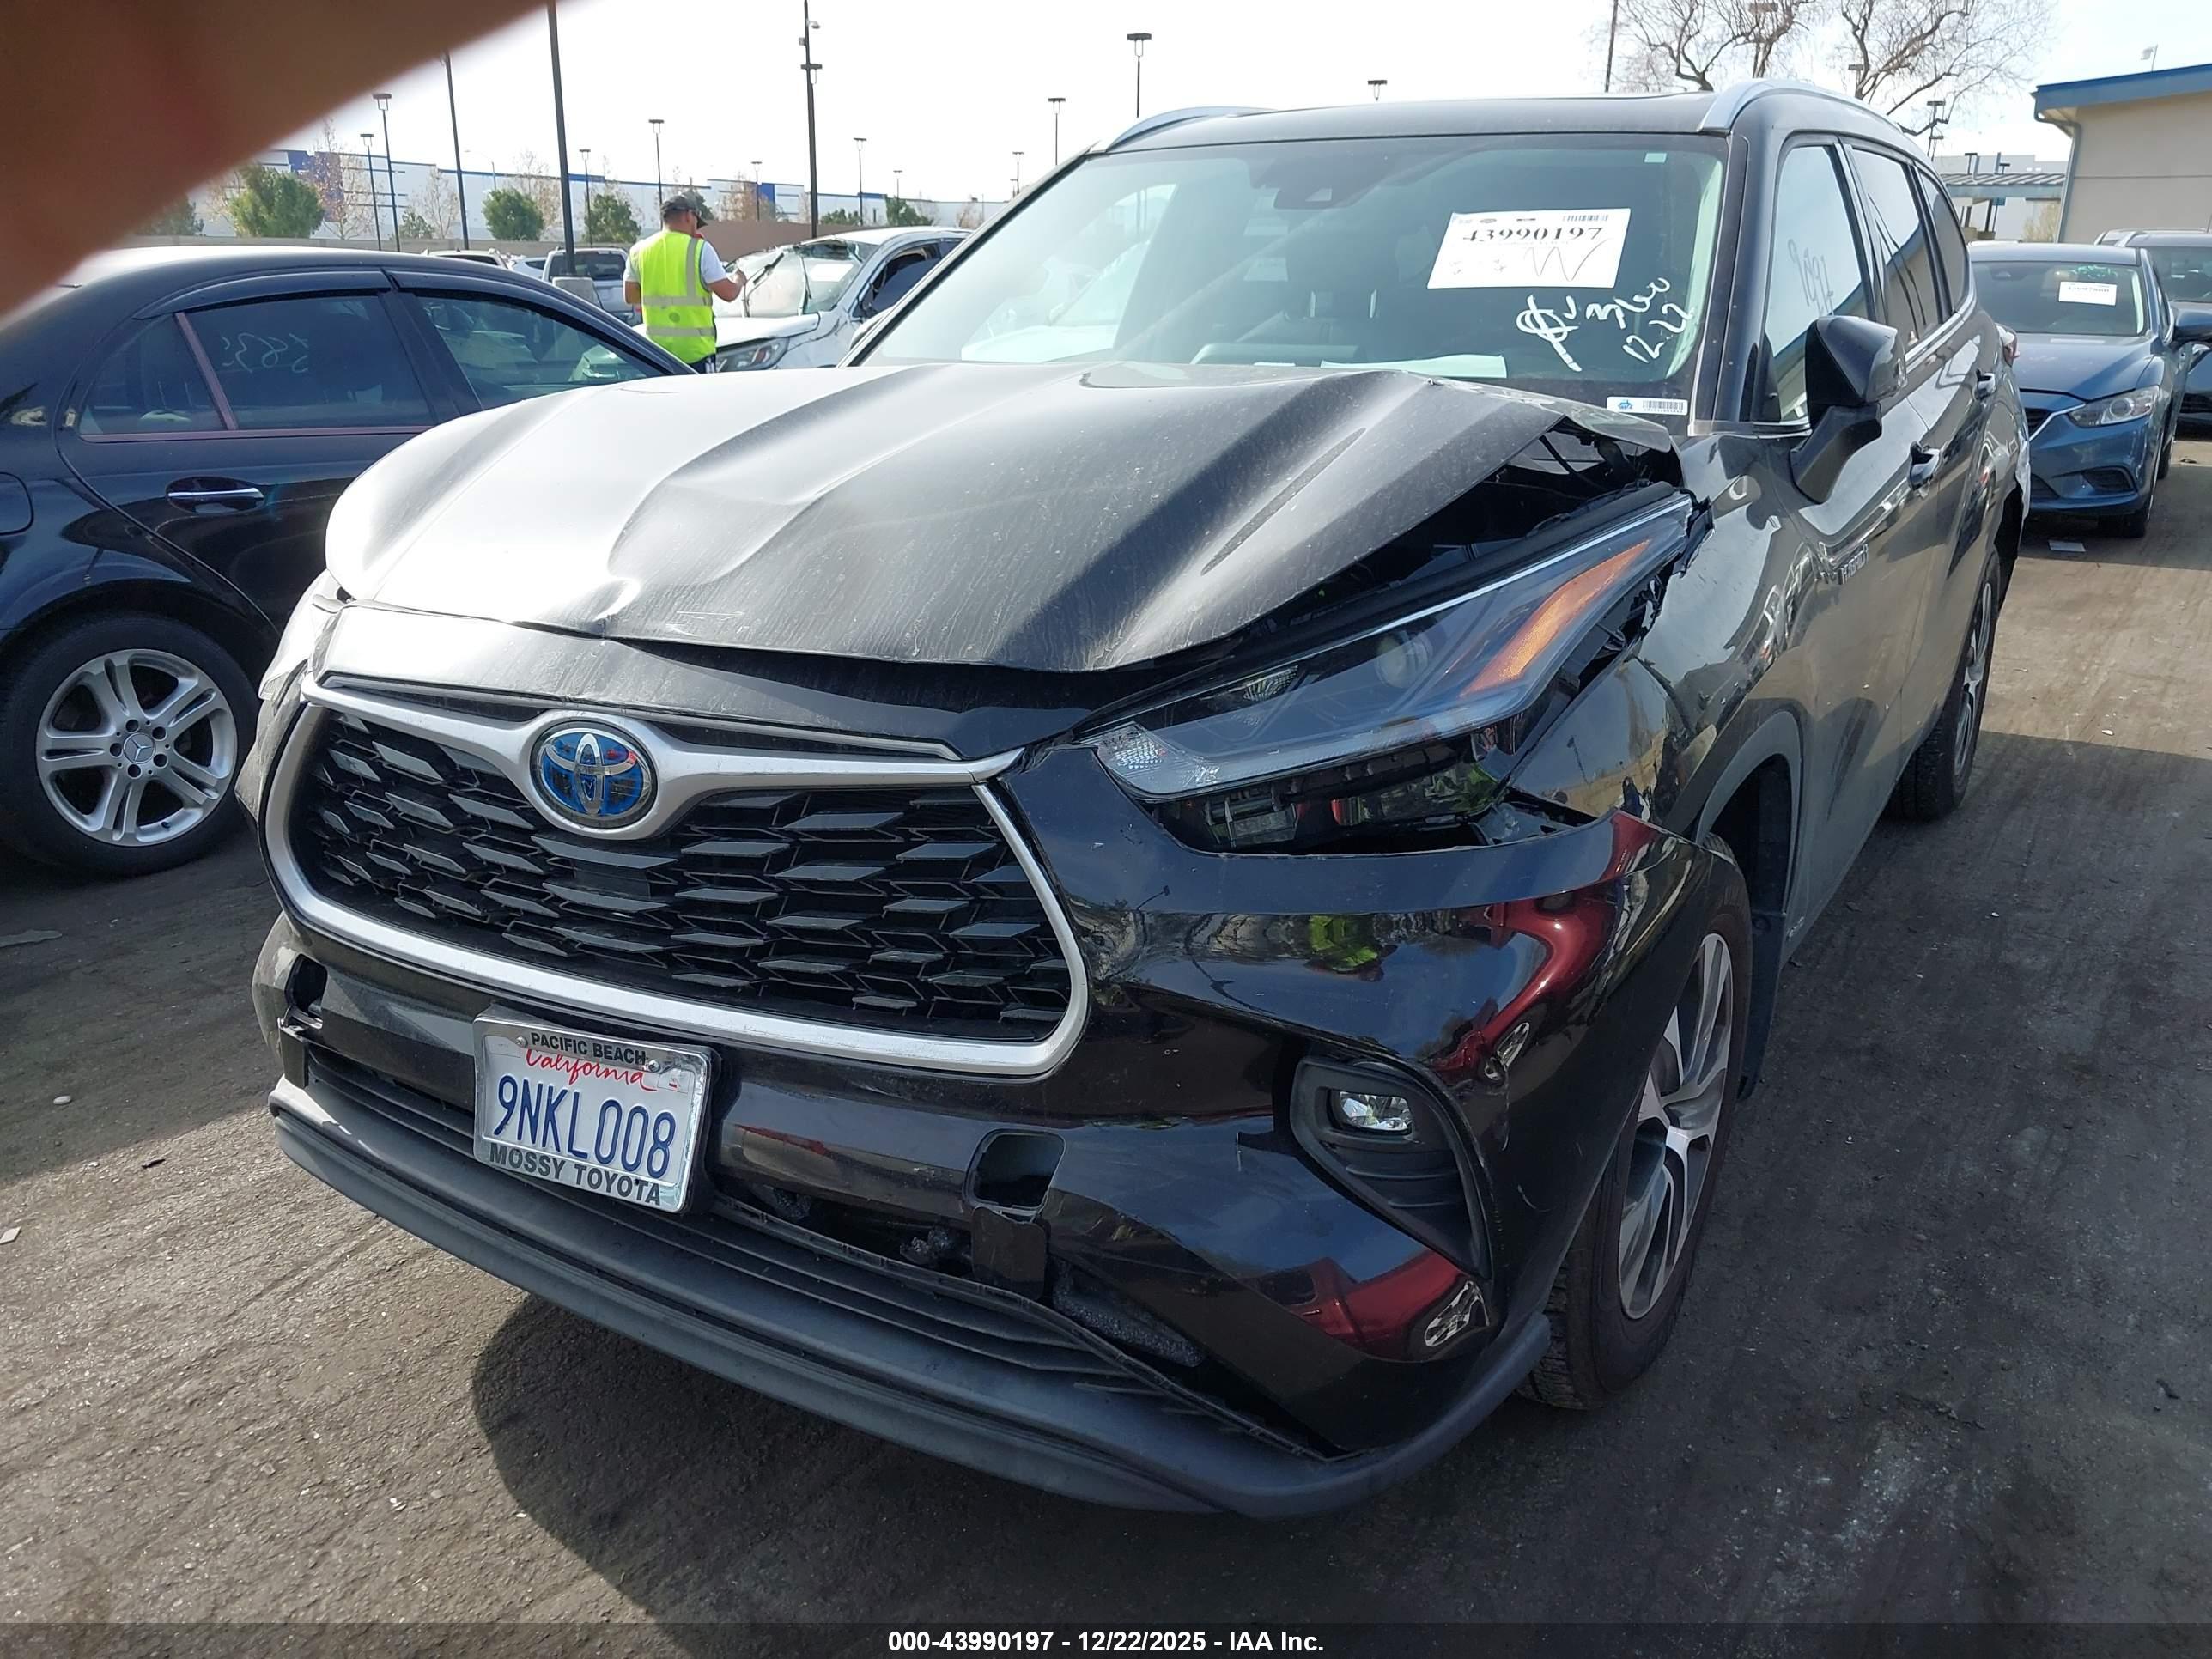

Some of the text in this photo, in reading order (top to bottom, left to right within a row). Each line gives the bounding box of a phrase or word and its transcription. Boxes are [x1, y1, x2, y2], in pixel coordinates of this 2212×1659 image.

[1462, 227, 1603, 242] 43990197
[531, 1032, 587, 1055] PACIFIC
[592, 1043, 647, 1065] BEACH
[526, 1049, 658, 1092] California
[494, 1074, 677, 1180] 9NKL008
[489, 1143, 661, 1206] MOSSY TOYOTA
